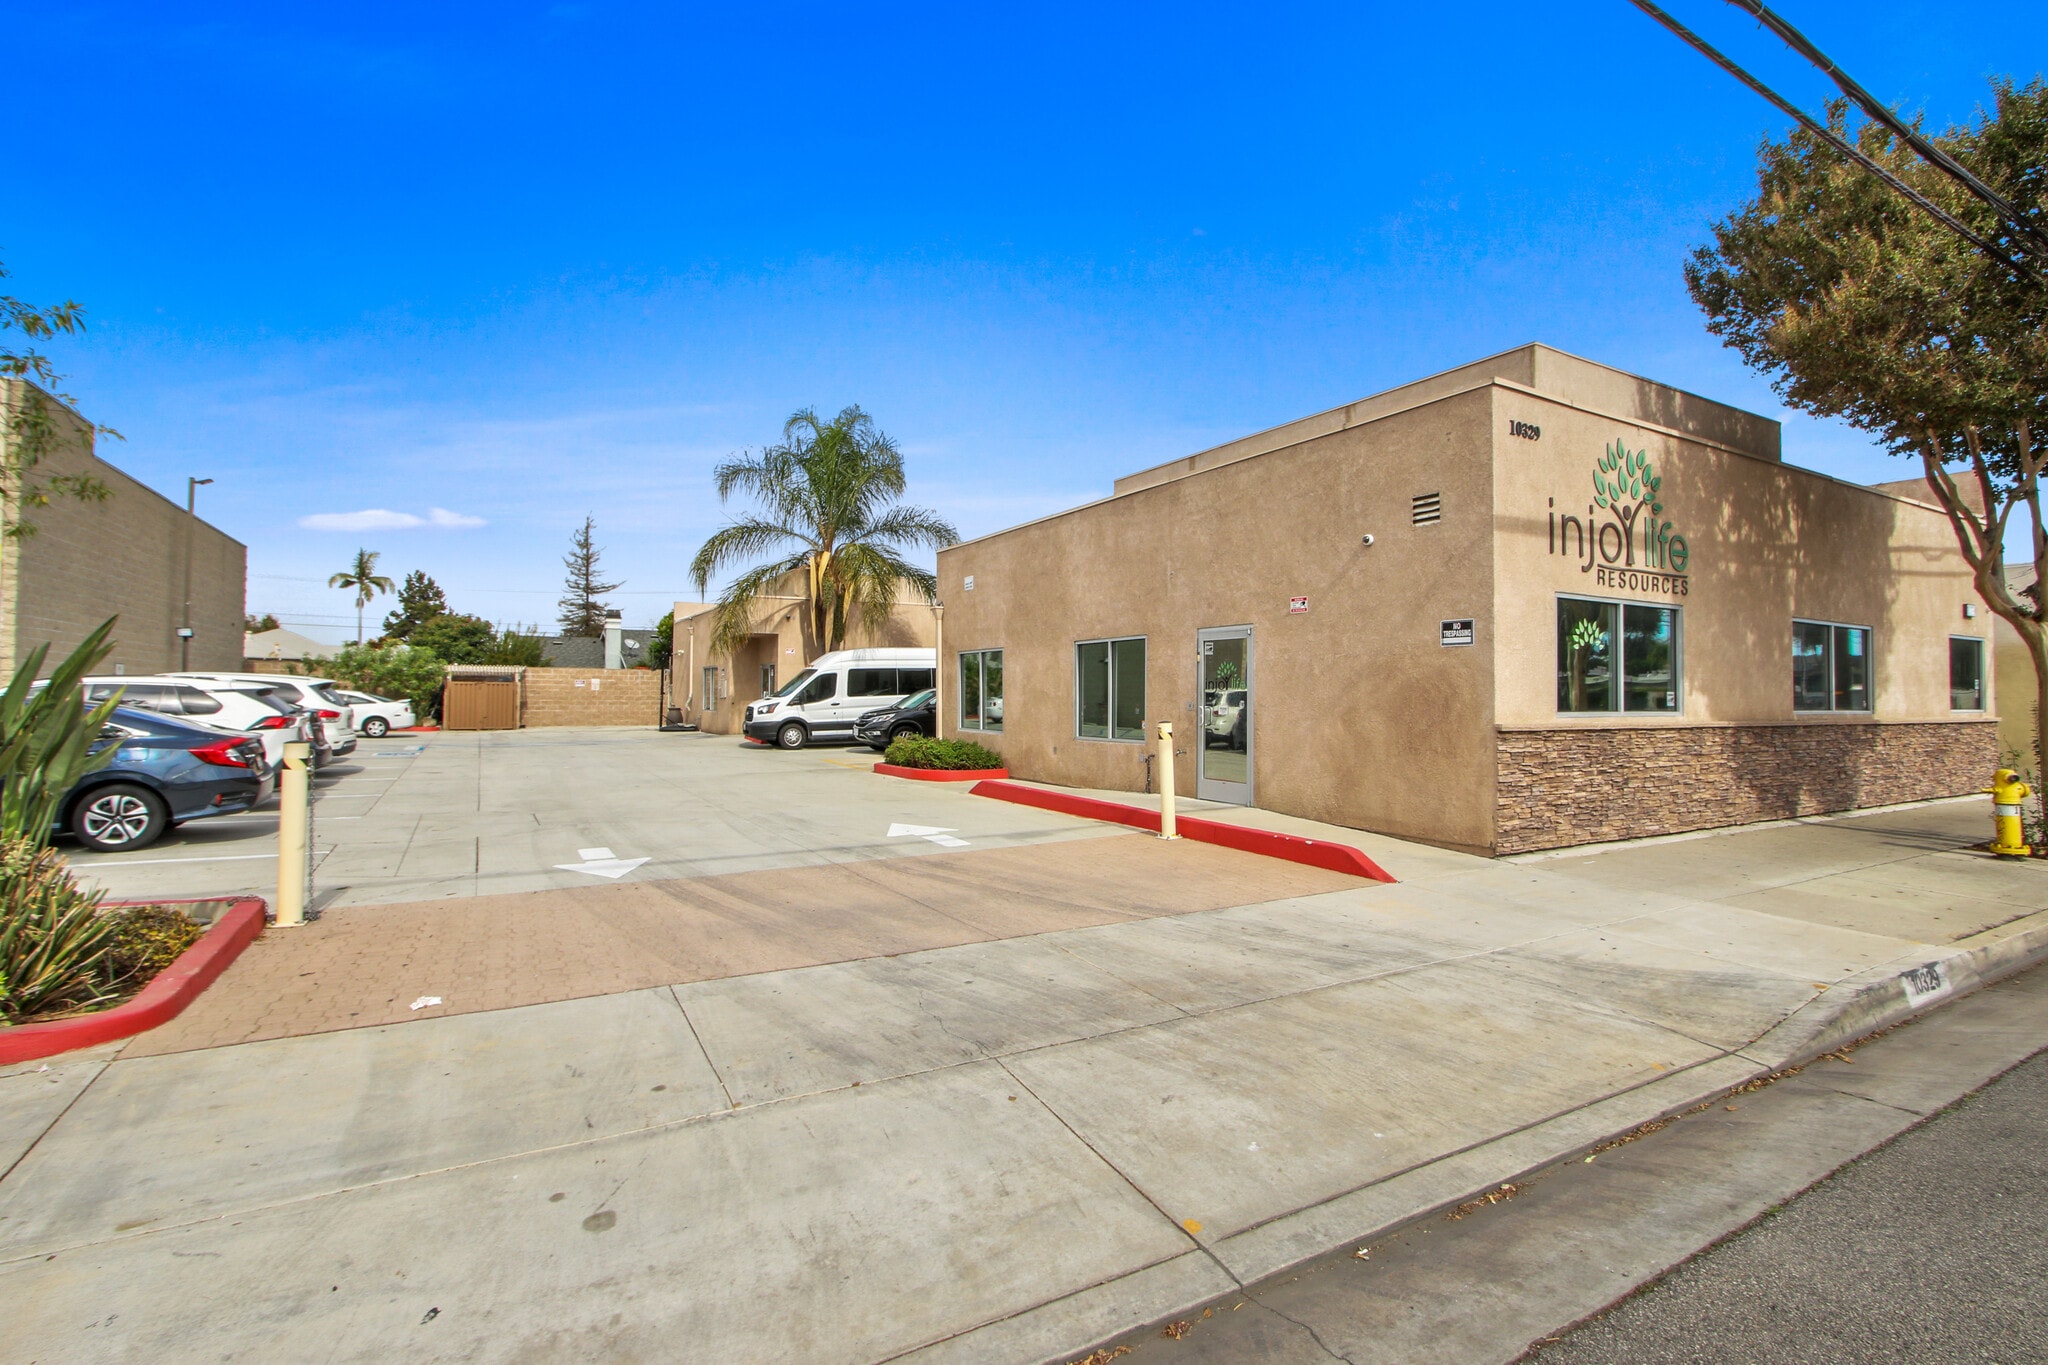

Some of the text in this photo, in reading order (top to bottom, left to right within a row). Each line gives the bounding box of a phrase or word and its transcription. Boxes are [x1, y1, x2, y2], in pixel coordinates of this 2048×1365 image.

[1509, 419, 1540, 441] 10329
[1597, 569, 1689, 596] RESOURCES
[1443, 629, 1471, 638] TRESPASSING
[1453, 622, 1461, 630] NO
